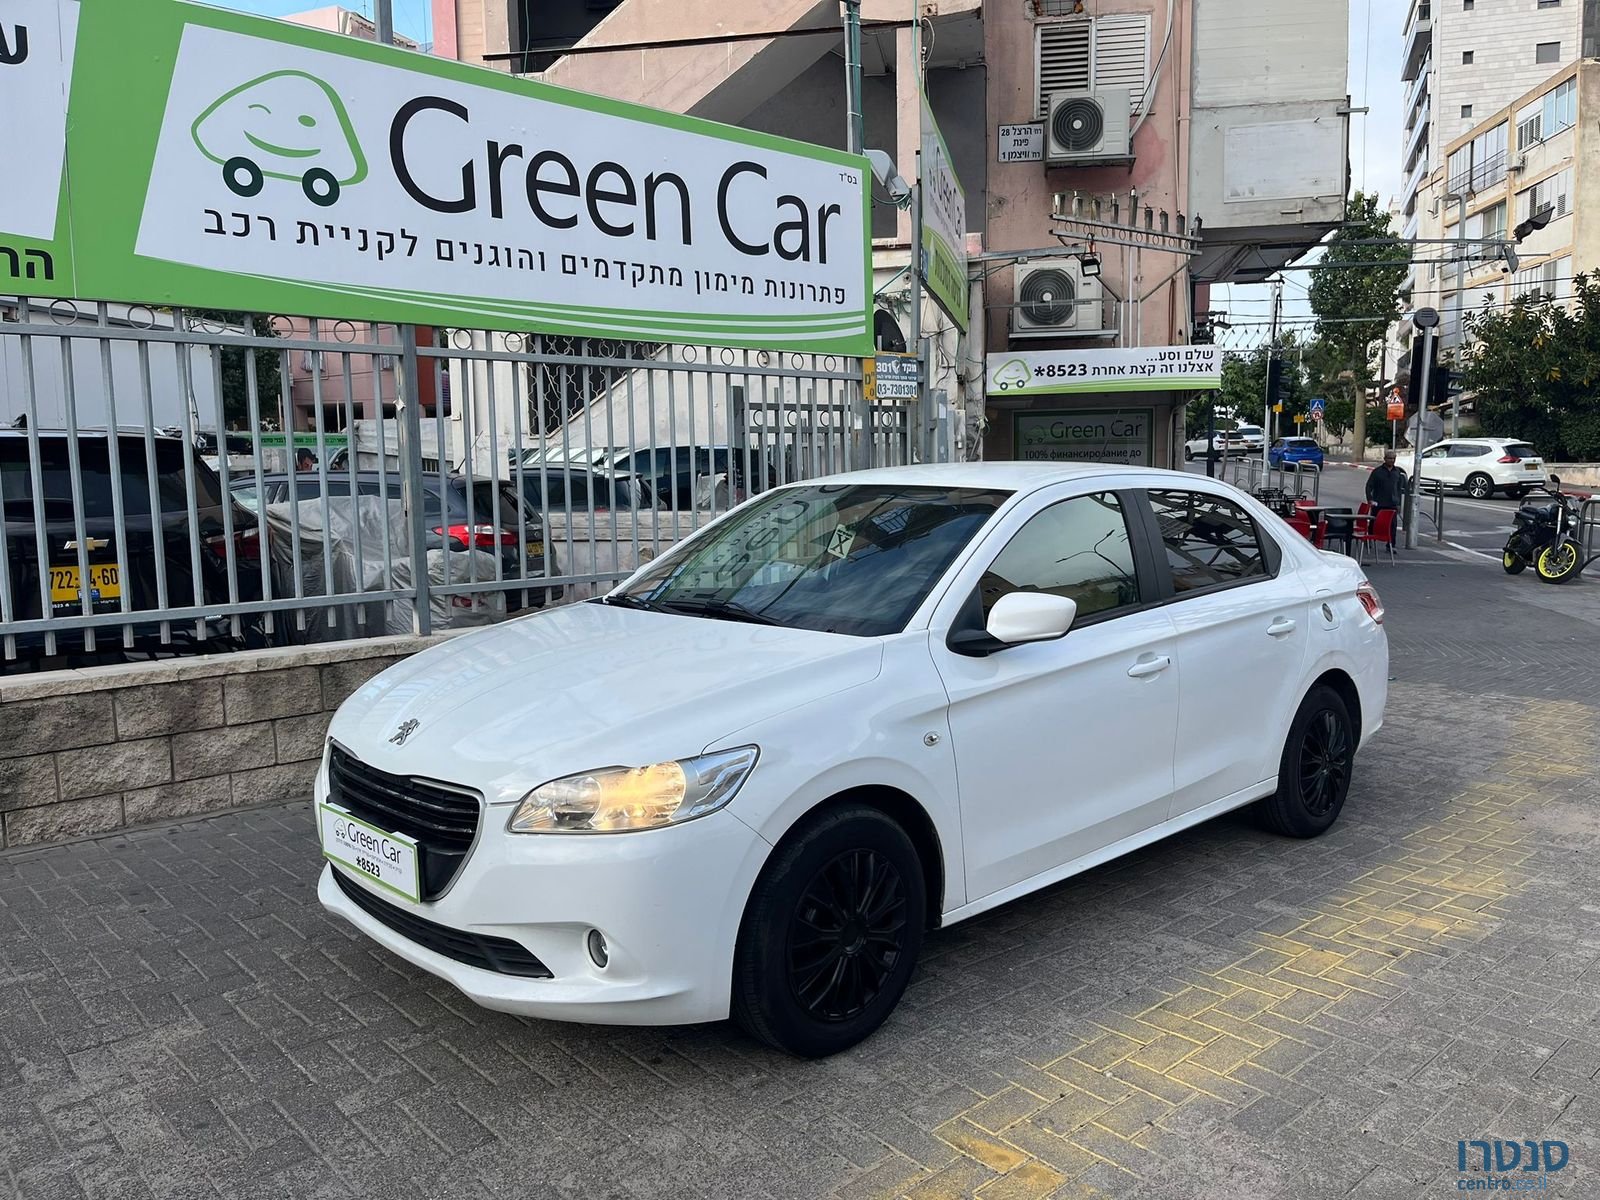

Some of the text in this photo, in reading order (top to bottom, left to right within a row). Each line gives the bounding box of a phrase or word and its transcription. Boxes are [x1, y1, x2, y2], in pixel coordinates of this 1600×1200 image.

[1012, 126, 1032, 136] הרצל
[389, 96, 692, 245] Green
[717, 161, 841, 264] Car
[839, 172, 857, 185] בס"ד
[204, 208, 845, 305] פתרונות מימון מתקדמים והוגנים לקניית רכב
[1146, 349, 1214, 361] שלם וסע...
[876, 362, 892, 372] 301
[1092, 365, 1126, 376] אחרת
[1130, 365, 1156, 376] קצת
[1160, 364, 1174, 373] זה
[1178, 361, 1214, 373] אצלנו
[877, 384, 917, 395] 03-7301301
[1051, 420, 1143, 438] Green Car
[1025, 450, 1048, 459] 100%
[1129, 449, 1142, 459] до
[347, 822, 380, 854] Green
[382, 838, 401, 864] Car
